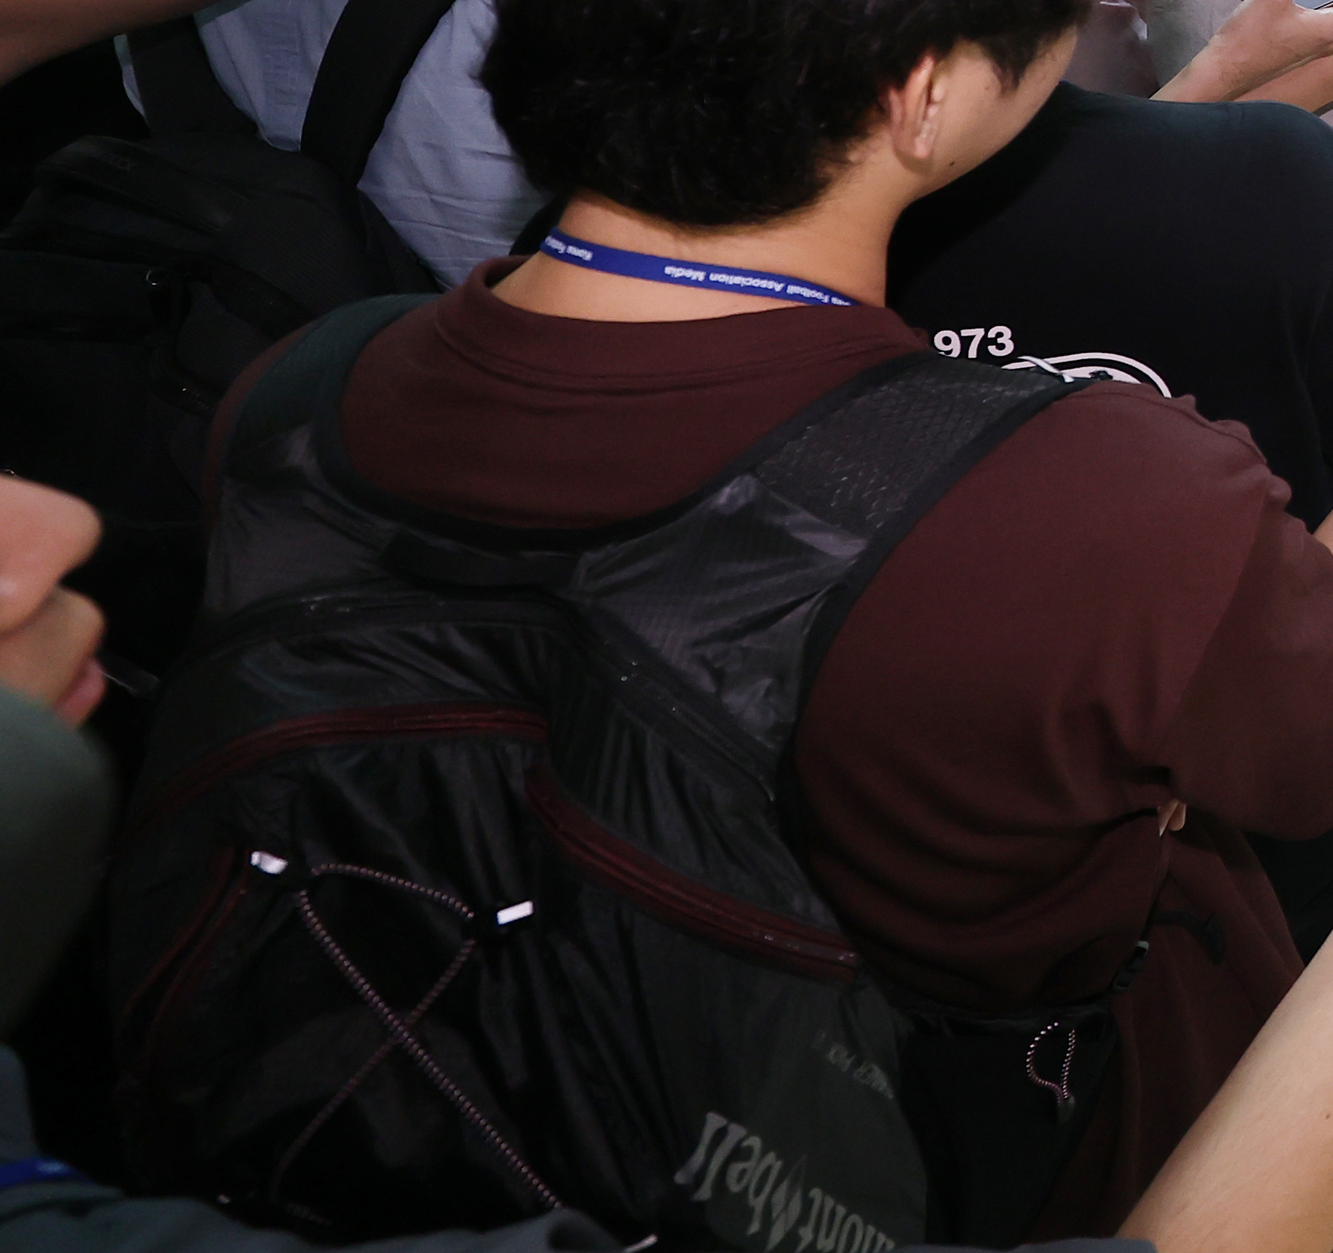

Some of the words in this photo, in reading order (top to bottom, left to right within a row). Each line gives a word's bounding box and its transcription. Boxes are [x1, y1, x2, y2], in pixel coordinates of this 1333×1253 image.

[664, 265, 705, 282] Media
[709, 271, 783, 293] Association
[786, 281, 830, 304] Football
